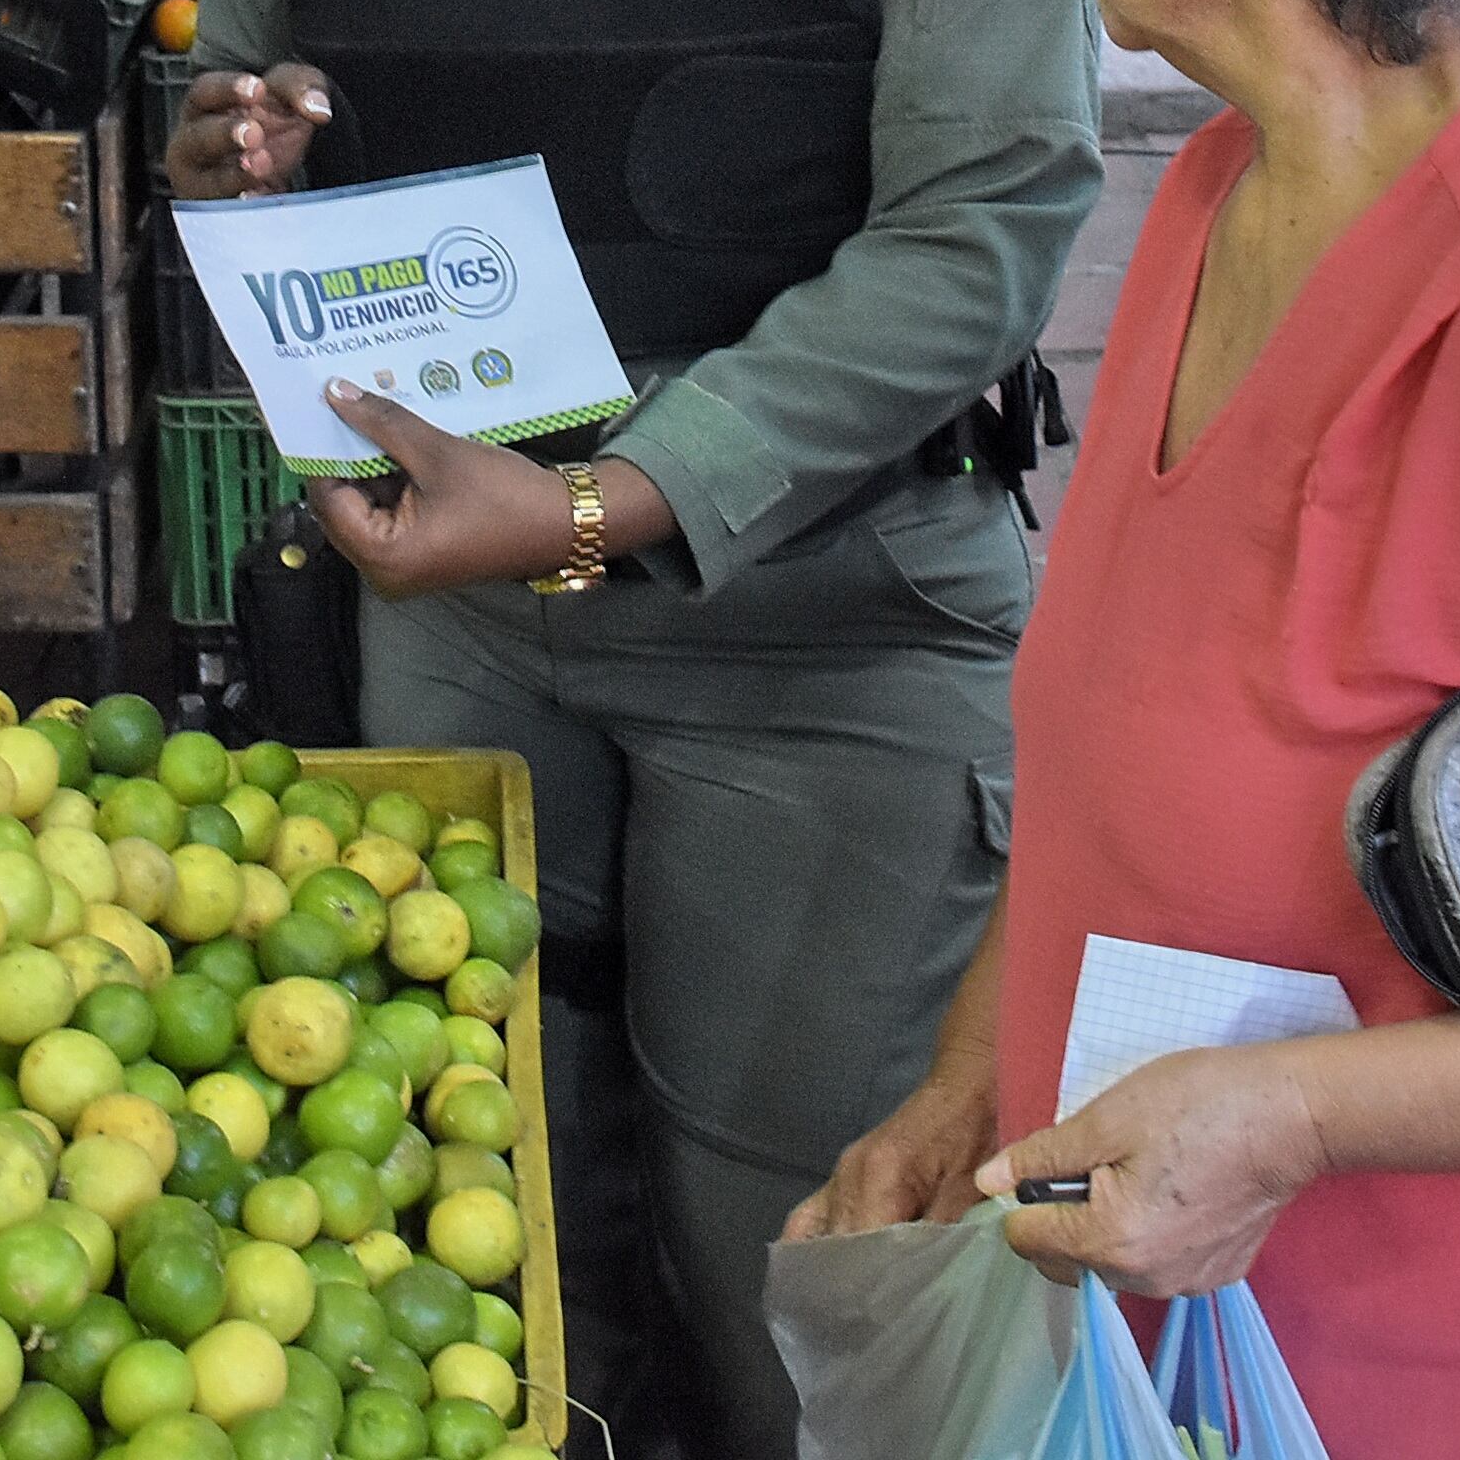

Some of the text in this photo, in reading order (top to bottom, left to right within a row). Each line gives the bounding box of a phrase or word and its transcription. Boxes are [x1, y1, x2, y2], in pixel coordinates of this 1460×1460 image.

[319, 257, 426, 300] NO PAGO
[442, 256, 500, 289] 165
[241, 270, 324, 344] YO
[329, 290, 438, 331] DENUNCIO
[374, 319, 452, 346] NACIONAL
